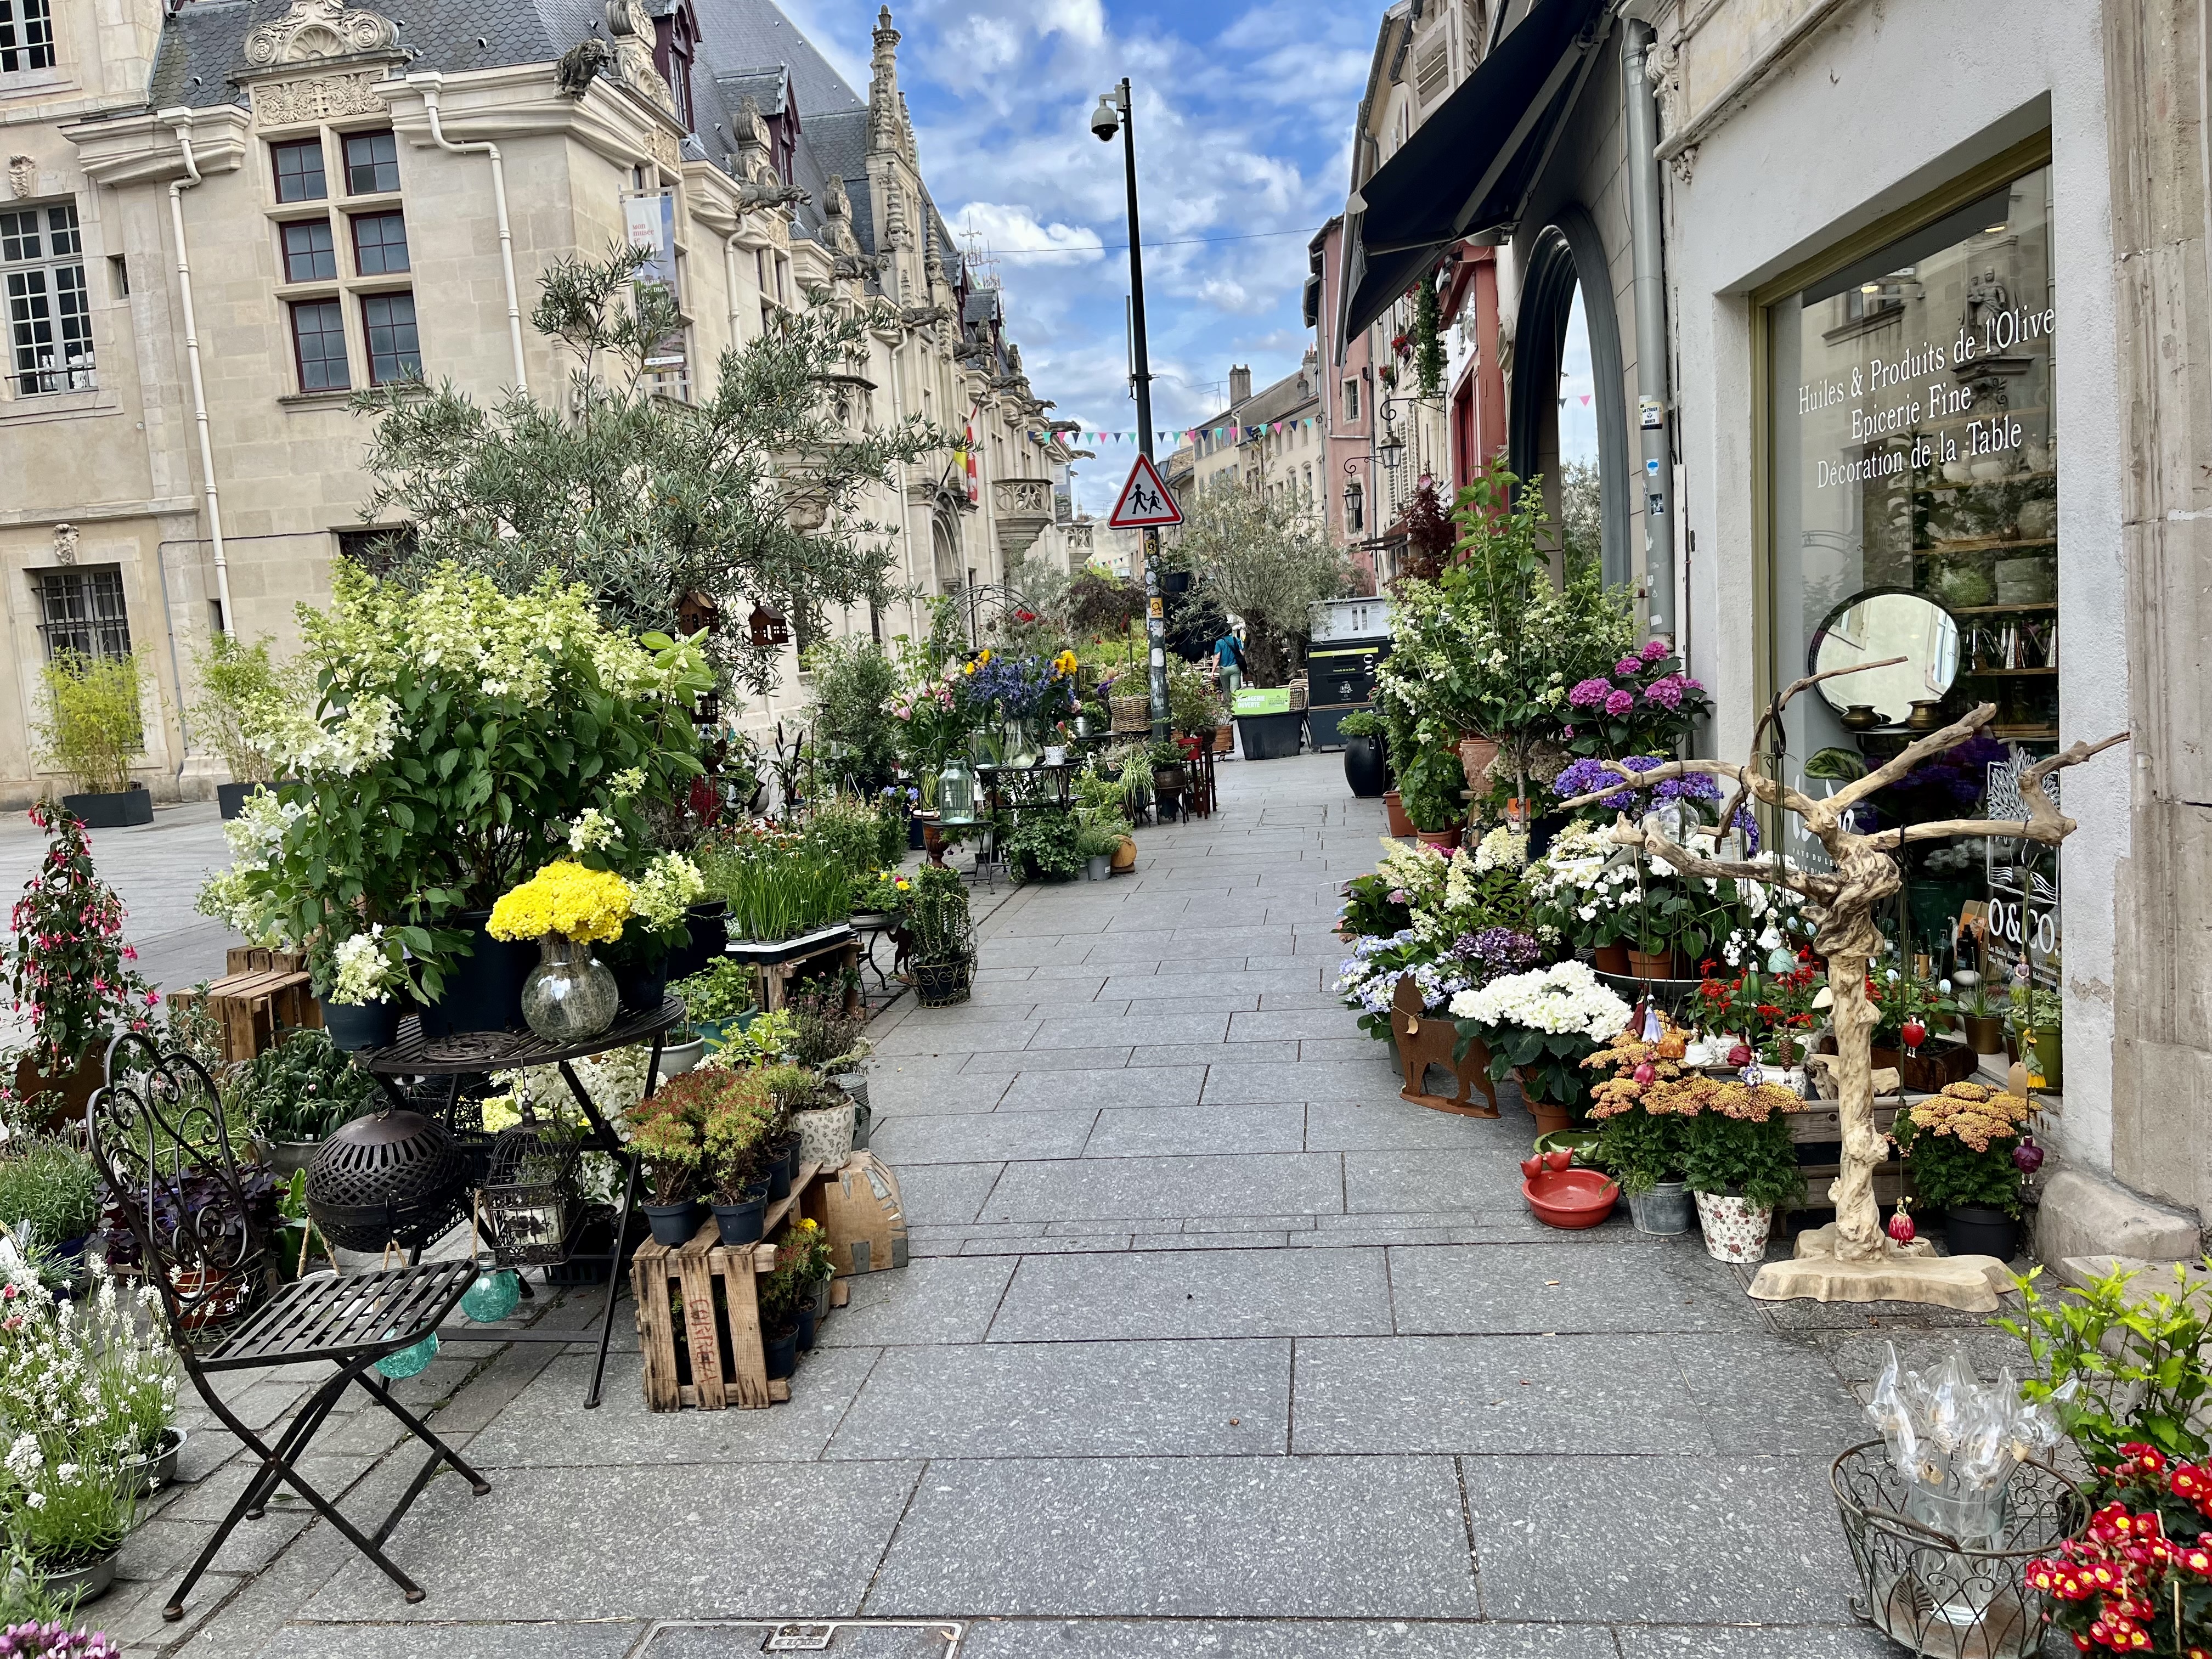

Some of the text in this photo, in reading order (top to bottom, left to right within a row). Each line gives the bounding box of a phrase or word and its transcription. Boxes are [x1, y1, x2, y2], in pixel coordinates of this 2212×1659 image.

[633, 228, 654, 236] musée
[1798, 304, 2056, 415] Huiles & Produits de l'Olive
[1850, 383, 1972, 444] Epicerie Fine
[1817, 414, 2023, 489] Décoration de la Table
[1792, 848, 1809, 859] PAYS
[1812, 854, 1821, 862] DU
